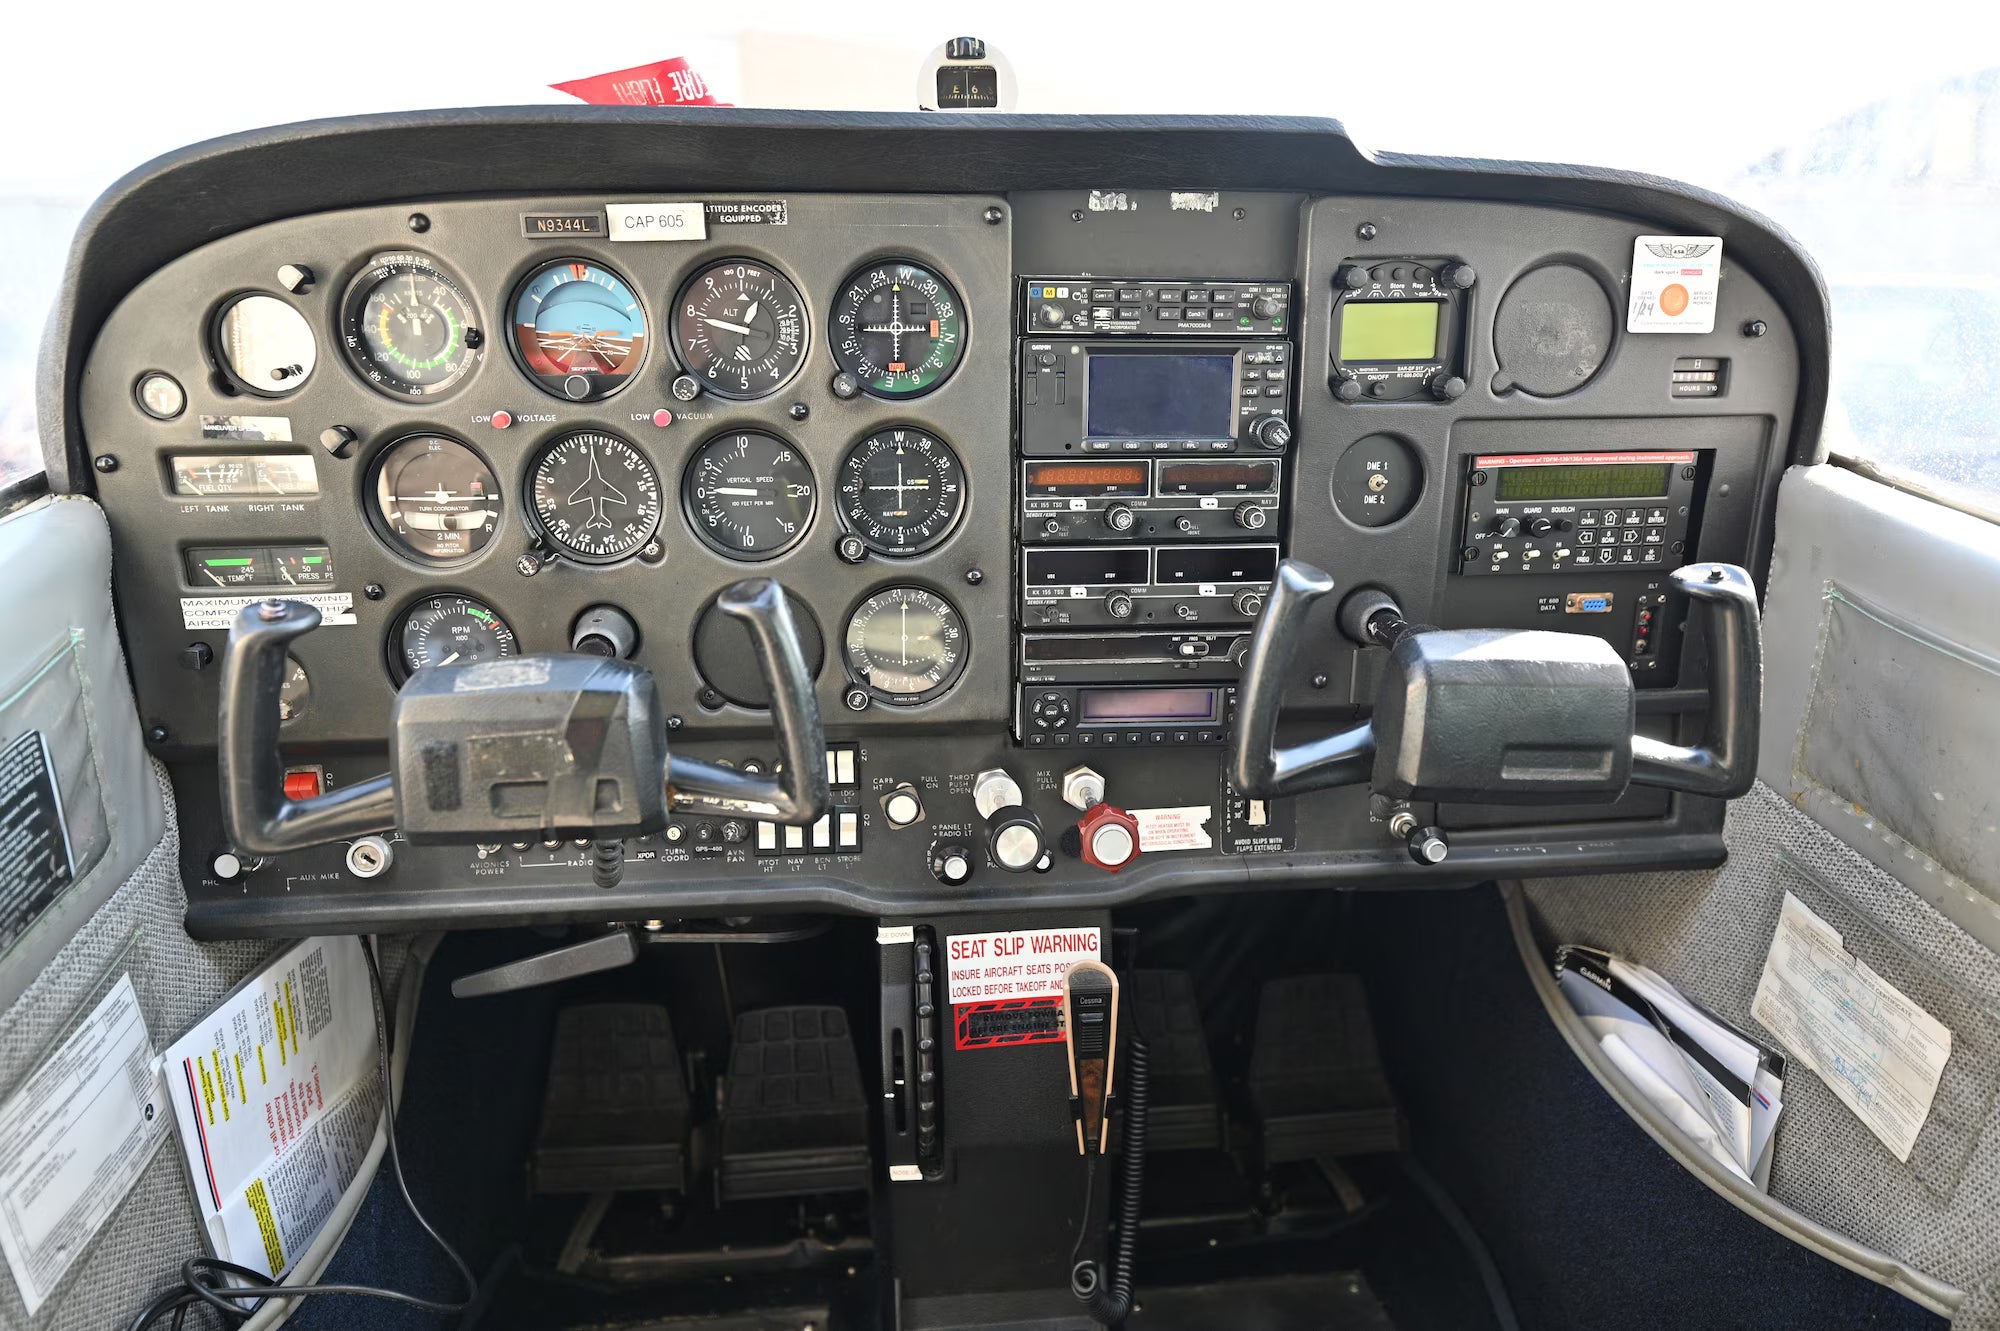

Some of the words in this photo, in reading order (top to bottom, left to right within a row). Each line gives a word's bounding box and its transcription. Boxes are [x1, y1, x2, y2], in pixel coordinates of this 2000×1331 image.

[705, 205, 738, 213] LTITUDE
[741, 205, 782, 213] ENCODER
[624, 215, 653, 229] CAP
[659, 214, 684, 227] 605
[720, 215, 761, 223] EQUIPPED
[537, 219, 590, 232] N9344L
[736, 267, 745, 279] 0
[747, 269, 761, 278] FEET
[870, 270, 886, 284] 24
[900, 269, 912, 279] W
[705, 277, 714, 289] 9
[923, 279, 939, 294] 30
[433, 286, 446, 296] 40
[849, 284, 864, 301] 21
[370, 293, 385, 302] 160
[687, 305, 696, 316] 8
[723, 308, 739, 316] ALT
[788, 305, 797, 316] 2
[942, 302, 954, 318] 33
[839, 314, 850, 323] S
[944, 333, 955, 343] N
[689, 339, 697, 350] 7
[790, 343, 798, 355] 3
[374, 353, 389, 362] 120
[446, 363, 457, 372] 80
[709, 367, 717, 378] 6
[406, 369, 421, 379] 100
[770, 368, 779, 379] 4
[740, 378, 748, 389] 5
[517, 414, 556, 422] VOLTAGE
[894, 432, 904, 442] W
[737, 437, 748, 448] 10
[919, 438, 931, 450] 30
[780, 451, 791, 462] 15
[704, 459, 712, 469] 5
[939, 456, 950, 469] 33
[1367, 462, 1381, 470] DME
[697, 488, 705, 499] 0
[797, 486, 810, 496] 20
[1364, 495, 1378, 503] DME
[1380, 495, 1385, 504] 2
[181, 505, 199, 513] LEFT
[249, 504, 274, 512] RIGHT
[709, 516, 717, 527] 5
[486, 524, 492, 532] R
[784, 523, 795, 533] 15
[743, 536, 754, 547] 10
[892, 589, 902, 598] 21
[917, 591, 928, 601] 24
[430, 600, 441, 609] 15
[408, 621, 419, 630] 10
[408, 649, 415, 658] 5
[413, 659, 421, 668] 3
[470, 861, 510, 869] AVIONICS
[300, 873, 317, 881] AUX
[951, 940, 987, 960] SEAT
[994, 937, 1024, 956] SLIP
[1031, 933, 1098, 954] WARNING
[952, 967, 980, 980] INSURE
[984, 965, 1023, 978] AIRCRAFT
[1026, 964, 1051, 975] SEATS
[952, 985, 981, 997] LOCKED
[984, 983, 1013, 994] BEFORE
[1016, 981, 1047, 992] TAKEOFF
[1050, 979, 1063, 990] AND
[1080, 997, 1102, 1005] Cessna
[282, 1091, 294, 1139] Abnormal
